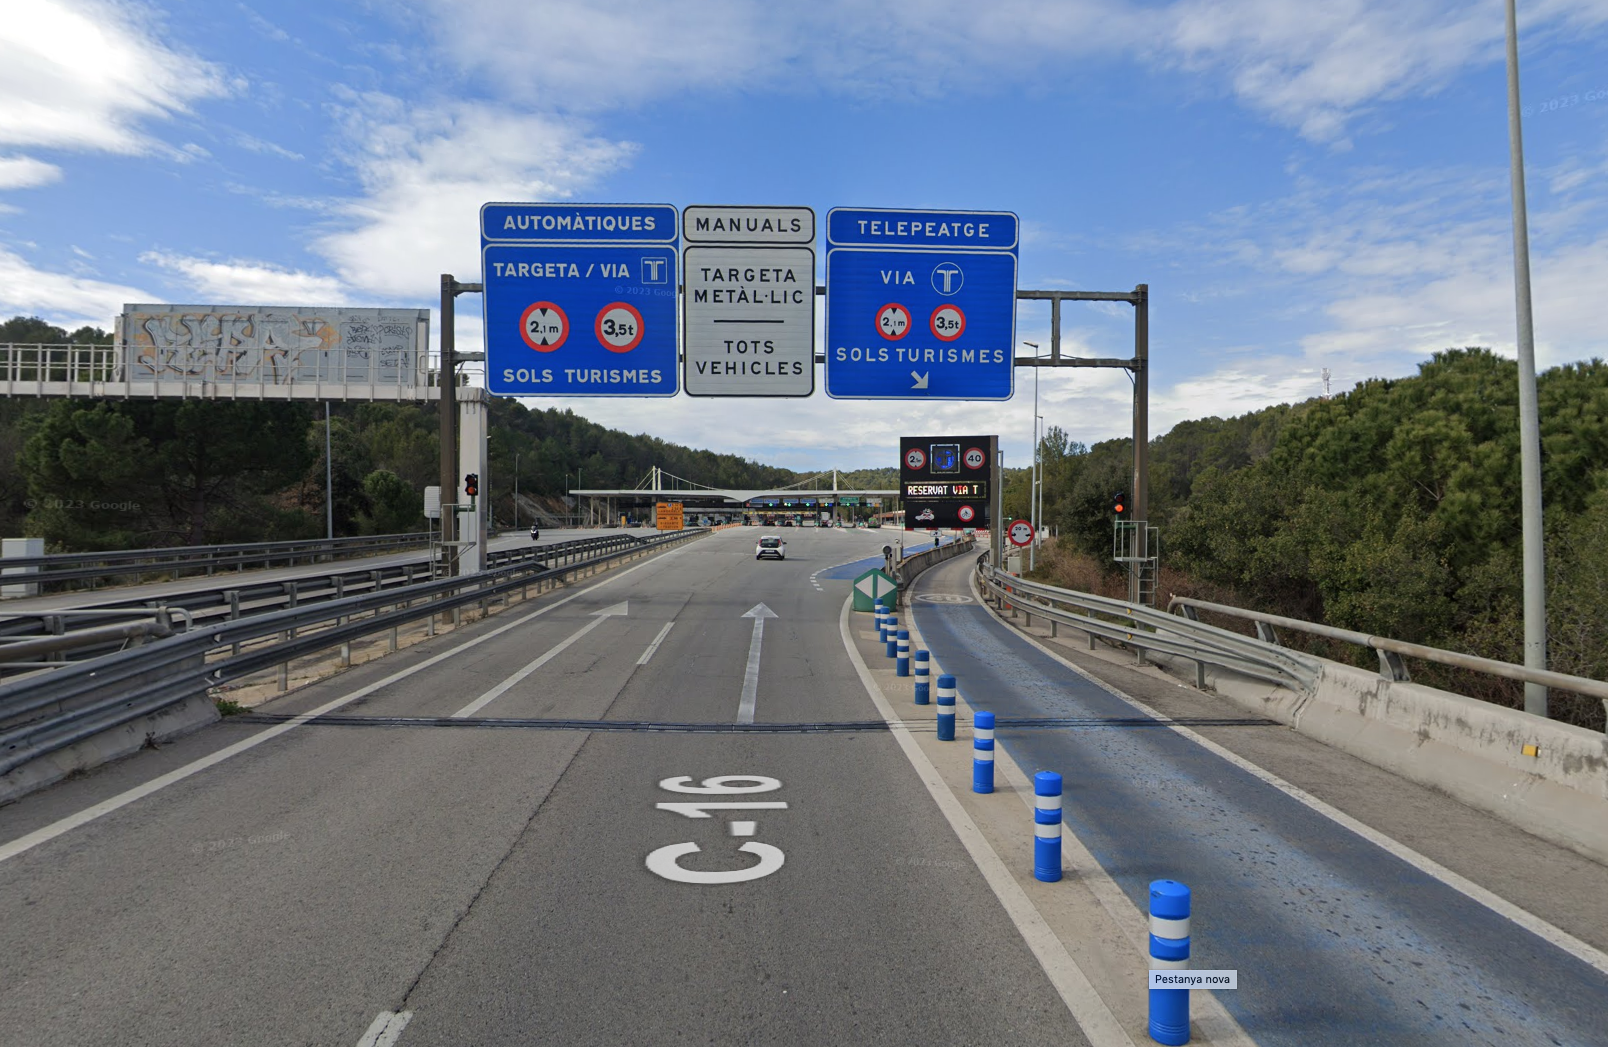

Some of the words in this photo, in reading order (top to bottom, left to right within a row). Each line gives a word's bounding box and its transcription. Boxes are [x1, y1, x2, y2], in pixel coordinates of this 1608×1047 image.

[503, 212, 656, 231] AUTOMÀTIQUES
[695, 217, 801, 232] MANUALS
[857, 220, 990, 238] TELEPEATGE
[493, 262, 580, 278] TARGETA
[586, 263, 595, 278] /
[600, 263, 630, 278] VIA
[700, 268, 796, 283] TARGETA
[880, 269, 915, 285] VIA
[694, 286, 804, 304] METÀL·LIC
[723, 340, 774, 354] TOTS
[836, 347, 889, 362] SOLS
[896, 347, 1004, 364] TURISMES
[503, 368, 554, 383] SOLS
[564, 368, 662, 384] TURISMES
[695, 360, 803, 376] VEHICLES
[967, 454, 982, 462] 40
[907, 485, 948, 495] RESERVAT
[952, 484, 968, 495] VIA
[972, 485, 979, 495] T
[645, 774, 789, 885] C-16
